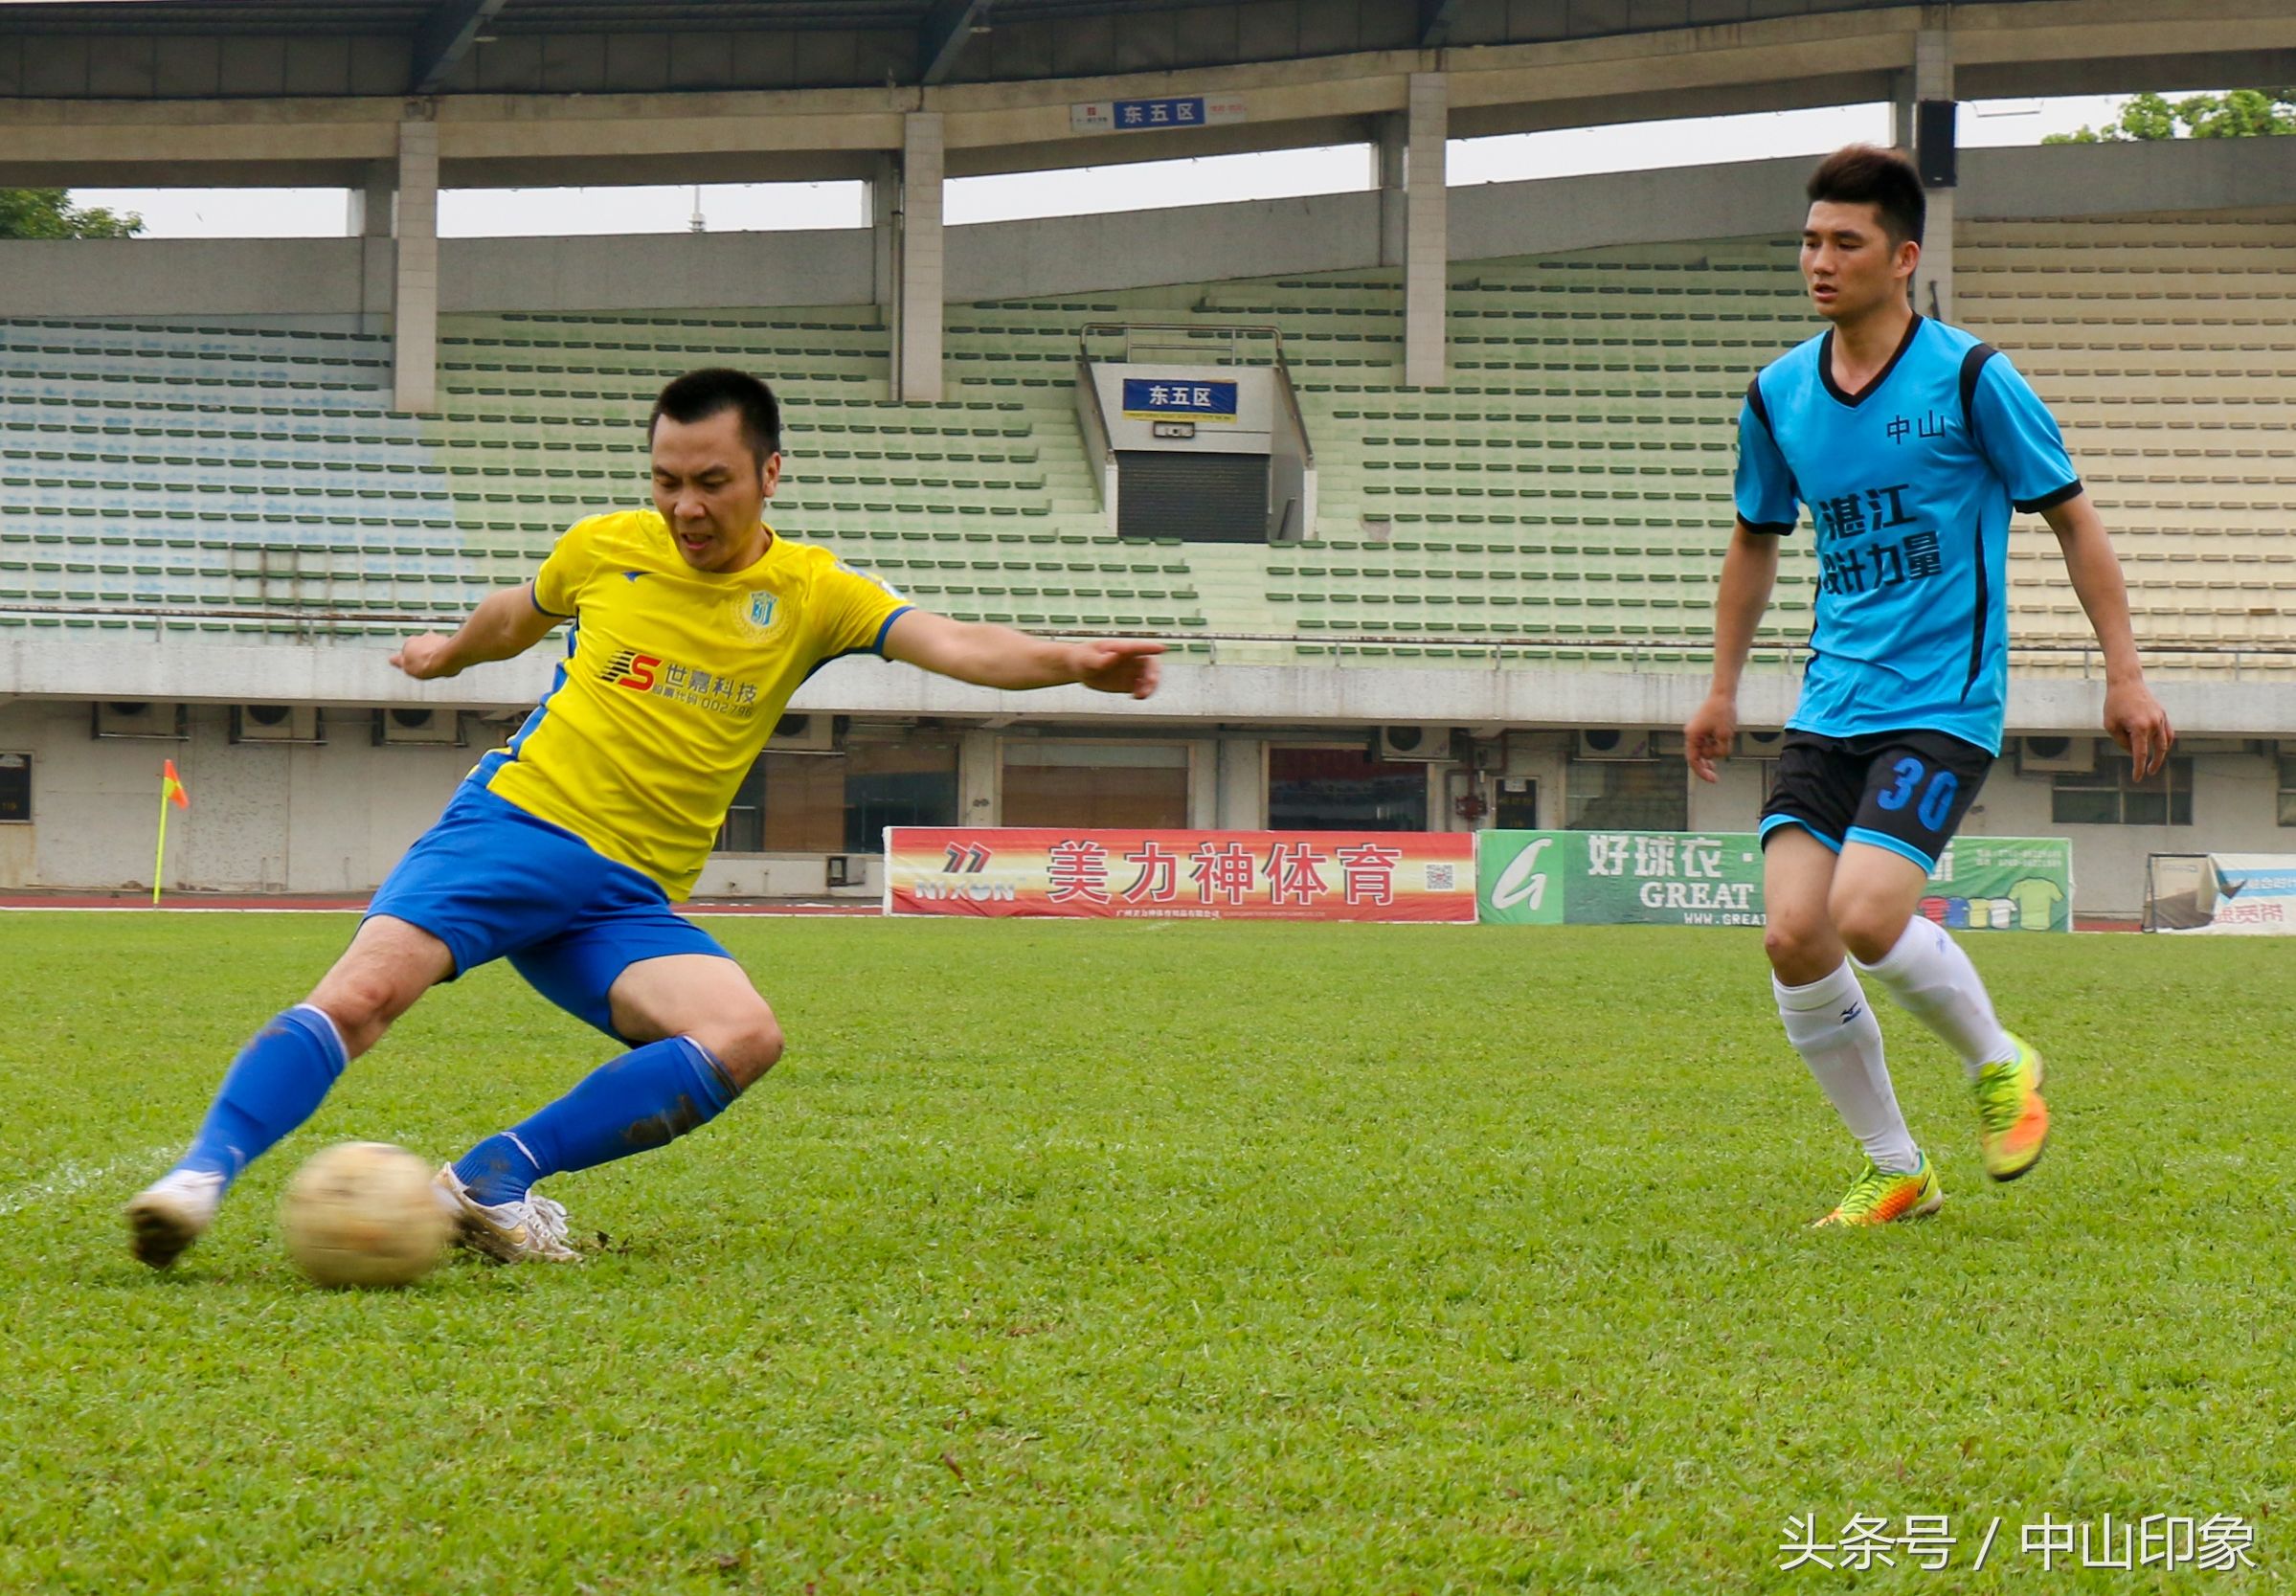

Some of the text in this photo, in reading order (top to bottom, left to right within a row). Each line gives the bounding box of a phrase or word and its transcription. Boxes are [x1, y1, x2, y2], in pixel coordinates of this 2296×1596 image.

[1124, 102, 1195, 124] 东五区
[1149, 386, 1211, 407] 东五区
[1886, 410, 1946, 444] 中山
[1819, 483, 1918, 541] 湛江
[701, 697, 753, 718] 002796
[1877, 756, 1959, 833] 30
[1047, 840, 1402, 906] 美力神体育
[1639, 881, 1755, 910] GREAT
